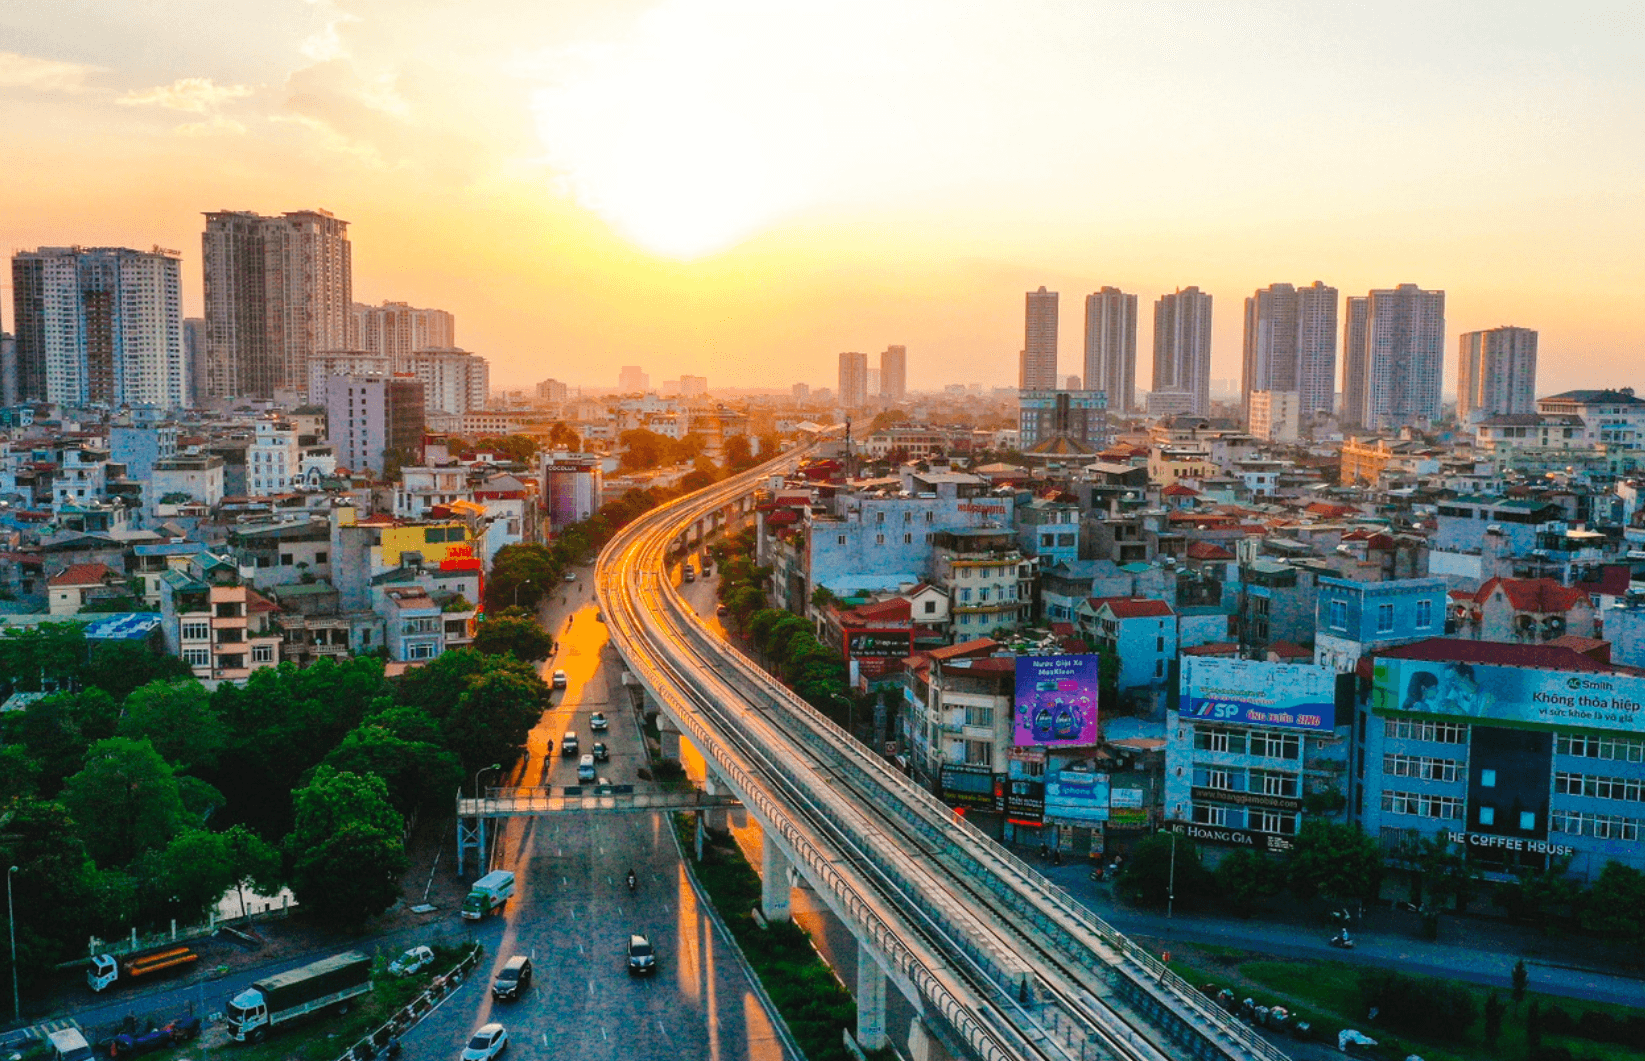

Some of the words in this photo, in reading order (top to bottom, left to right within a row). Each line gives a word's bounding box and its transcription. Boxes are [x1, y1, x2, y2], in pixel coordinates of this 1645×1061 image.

[1582, 680, 1613, 690] Smith
[1214, 703, 1239, 718] SP
[1532, 692, 1575, 707] Không
[1578, 695, 1608, 708] thỏa
[1611, 698, 1640, 712] hiệp
[1195, 789, 1298, 808] www.hoanggiamobile.com
[1187, 826, 1230, 841] HOANG
[1231, 832, 1253, 845] GIA
[1447, 831, 1466, 844] HE
[1470, 834, 1523, 850] COFFEE
[1527, 840, 1574, 856] HOUSE
